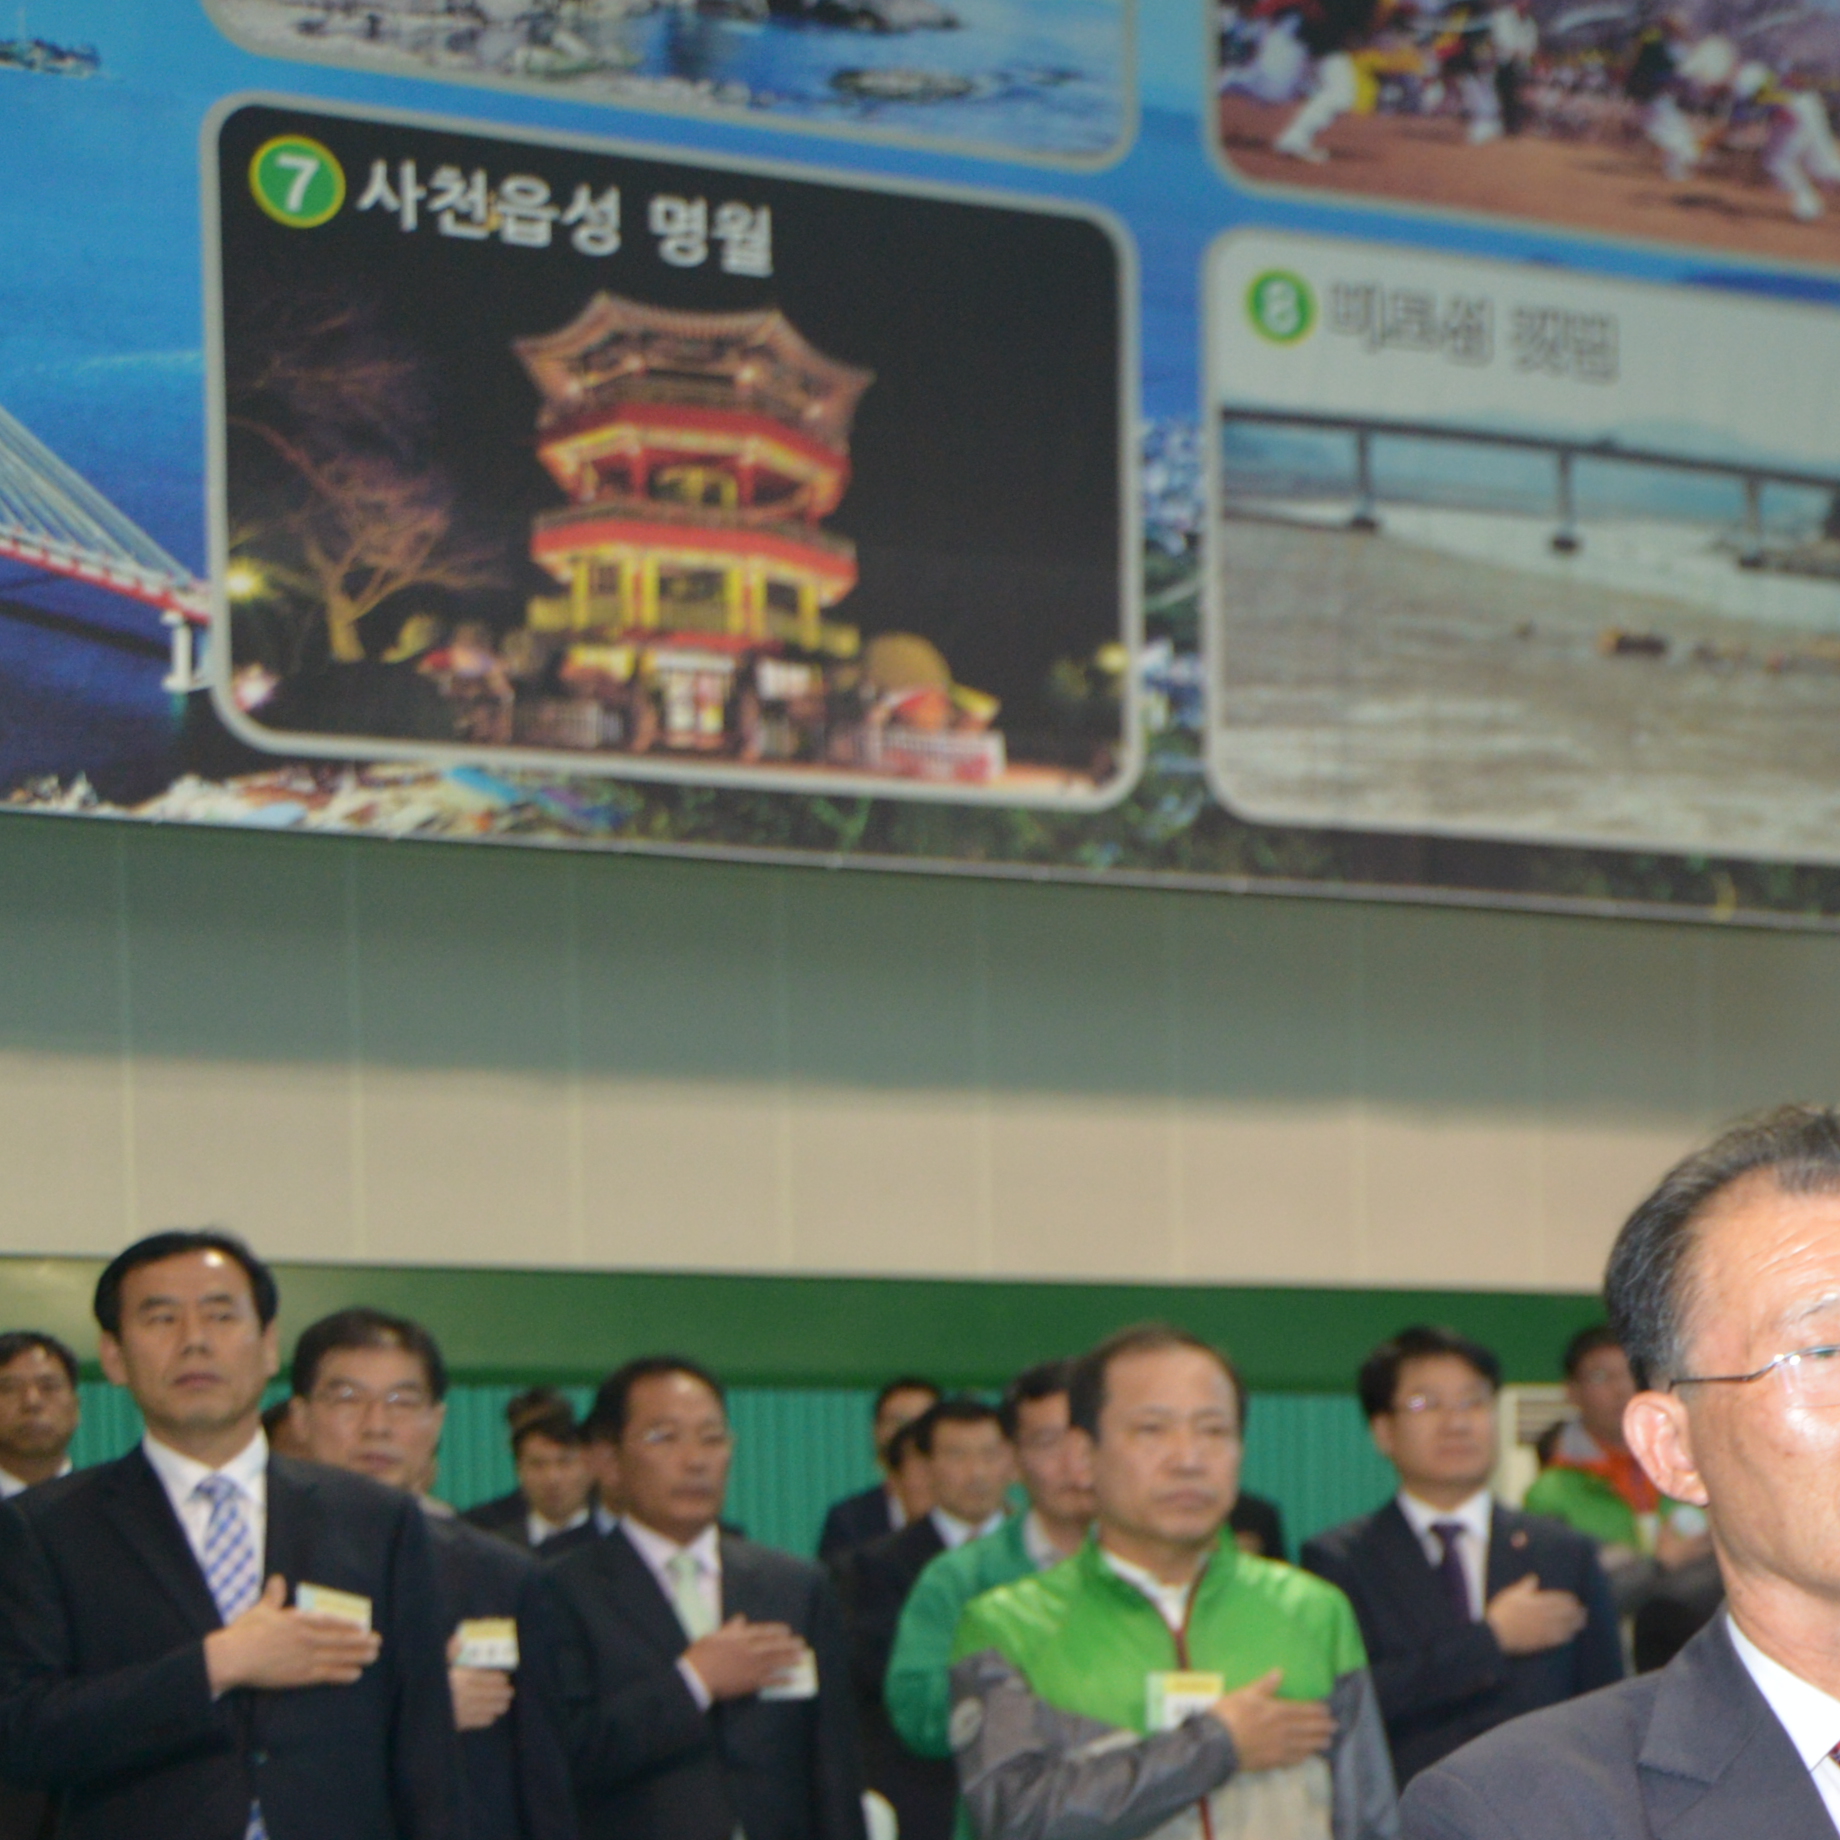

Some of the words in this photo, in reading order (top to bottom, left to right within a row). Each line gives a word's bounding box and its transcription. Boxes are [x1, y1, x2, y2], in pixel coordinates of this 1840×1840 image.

[276, 154, 319, 212] 7
[355, 157, 622, 257] 사천읍성
[647, 194, 774, 279] 명월
